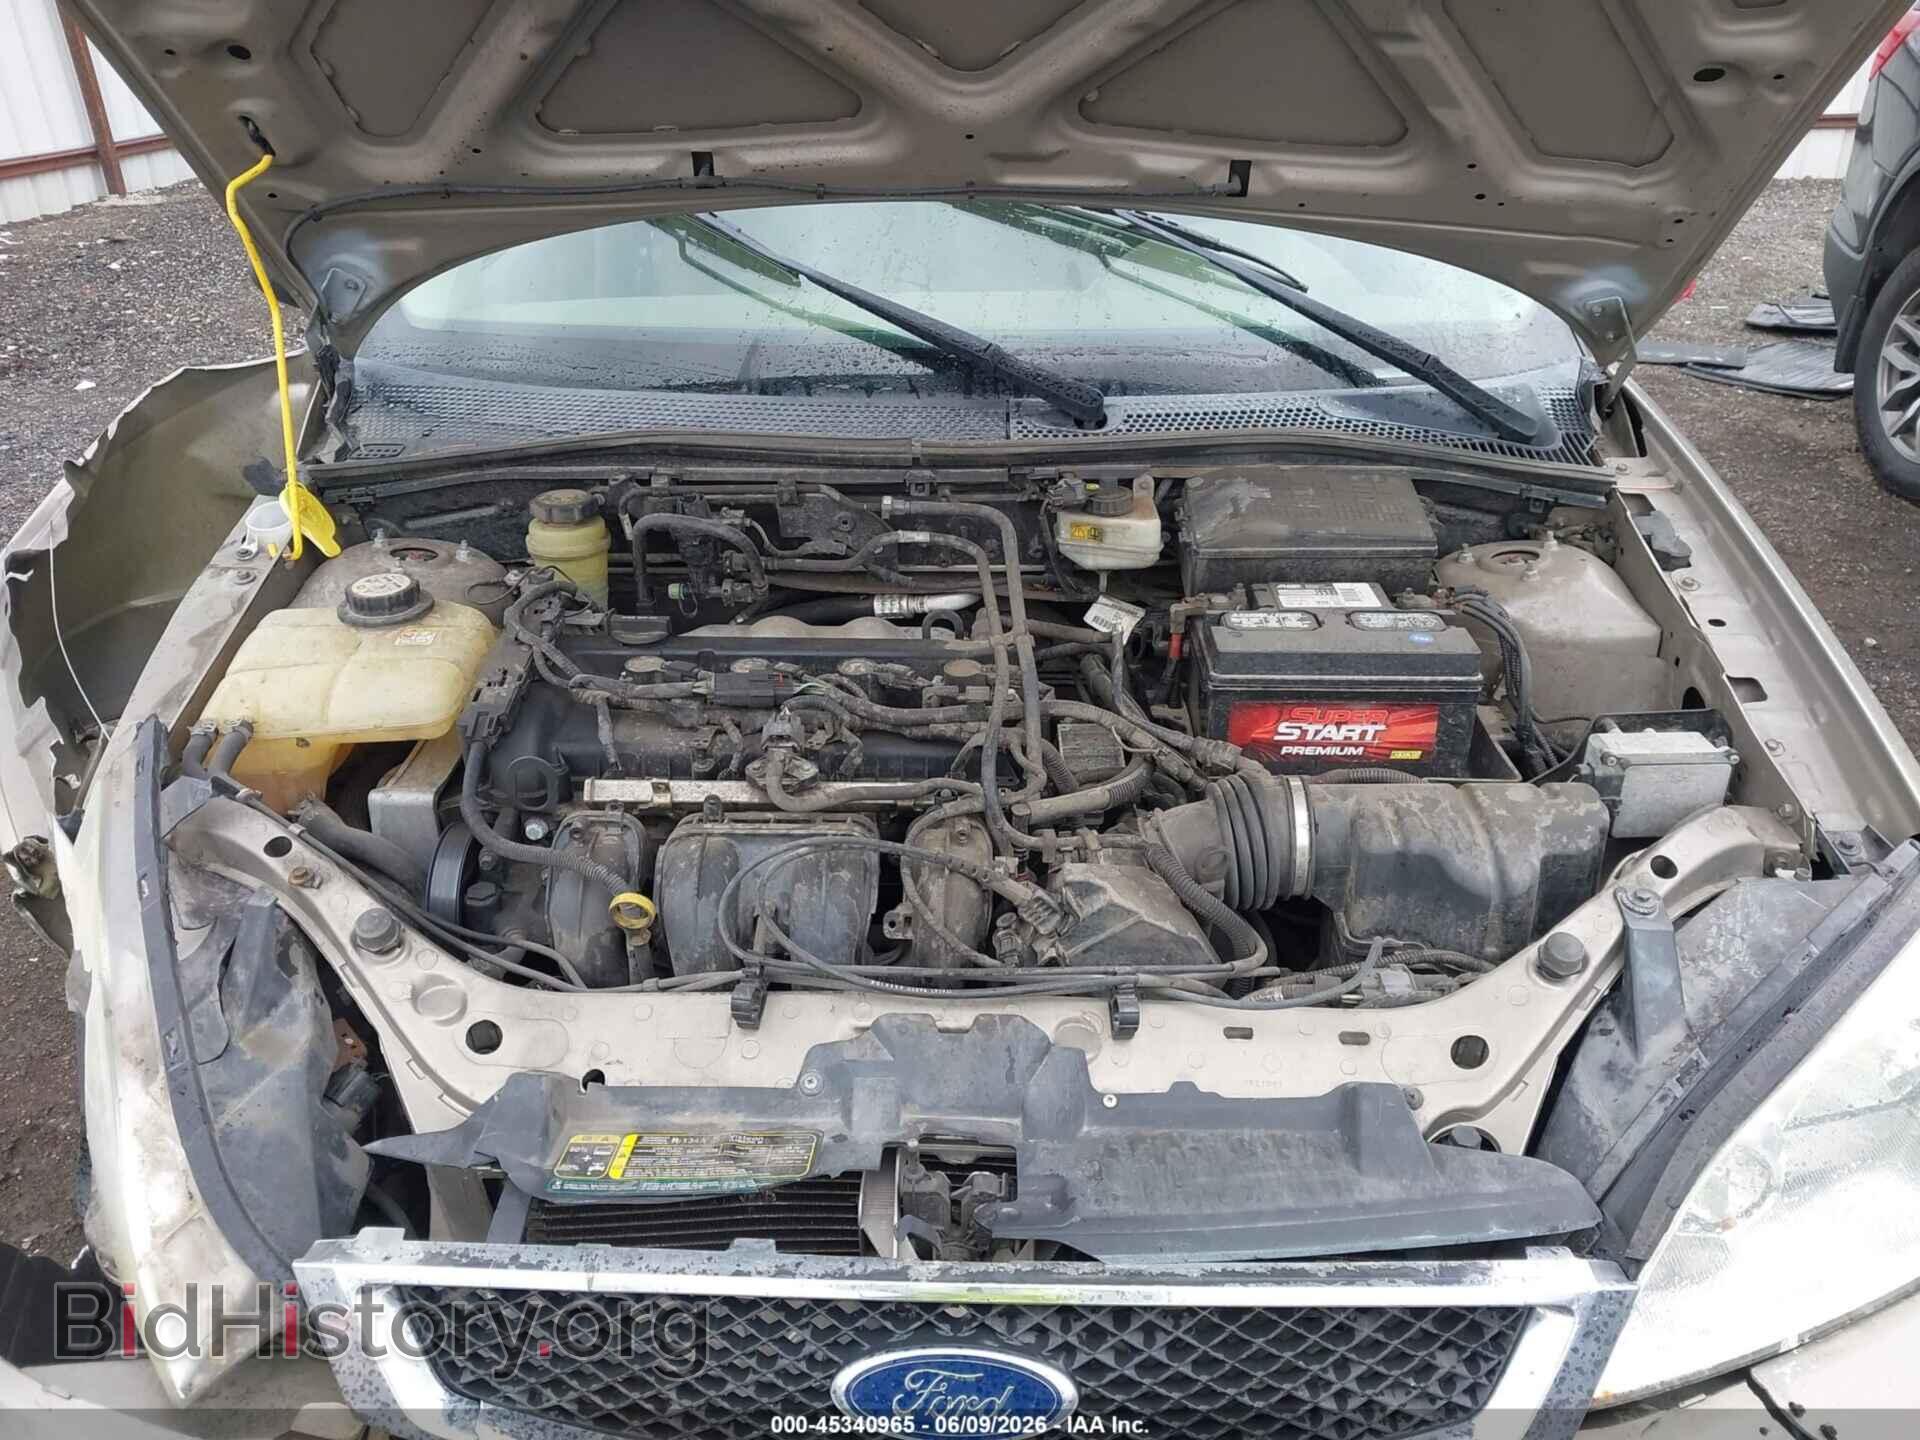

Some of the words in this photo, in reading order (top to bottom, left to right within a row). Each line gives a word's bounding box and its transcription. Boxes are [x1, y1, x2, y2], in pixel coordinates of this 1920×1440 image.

[1290, 707, 1389, 724] SUPER
[1273, 721, 1389, 741] START
[1280, 746, 1365, 756] PREMIUM
[892, 1368, 1015, 1419] Ford
